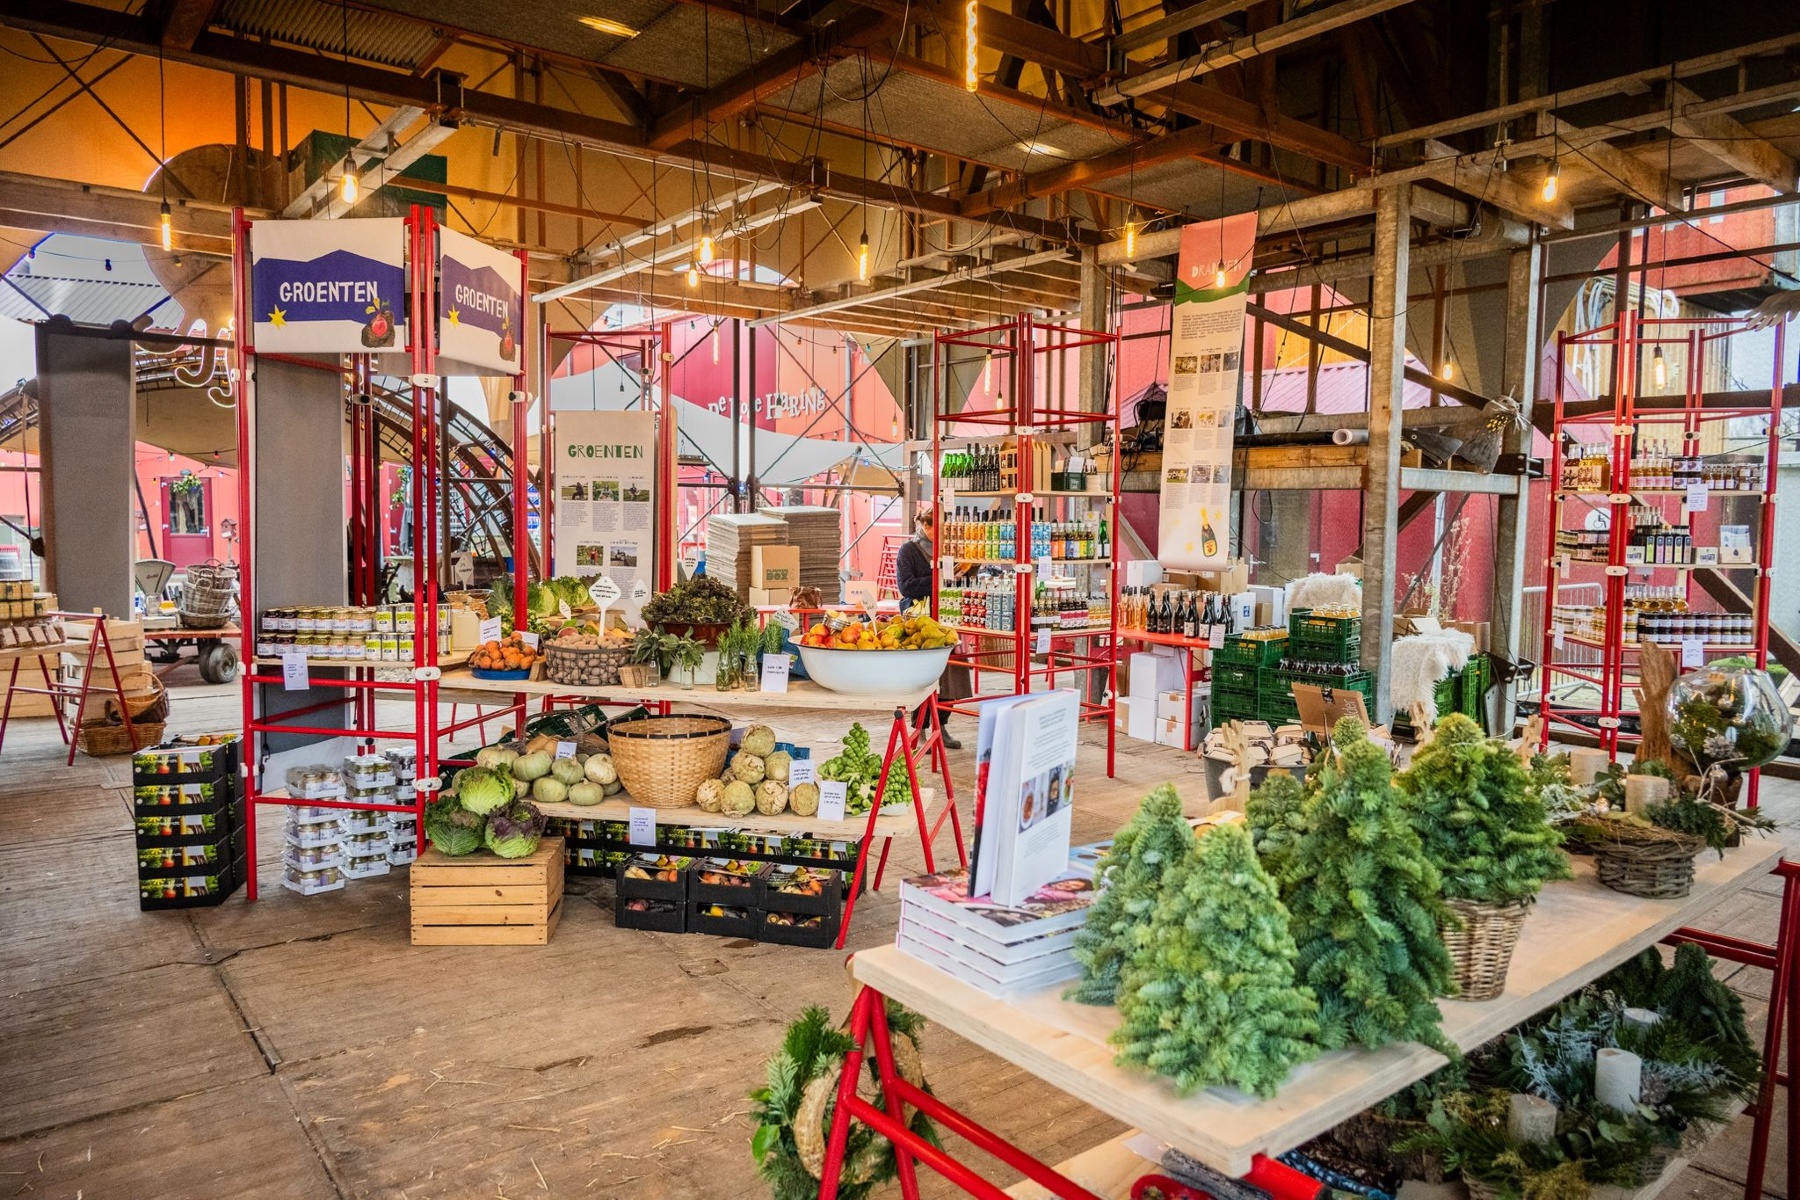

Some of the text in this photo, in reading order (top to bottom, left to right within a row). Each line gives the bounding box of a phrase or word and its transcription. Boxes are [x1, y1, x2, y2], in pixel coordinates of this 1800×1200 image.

[279, 281, 378, 303] GROENTEN
[455, 284, 509, 318] GROENTEN
[568, 444, 643, 458] GROENTEN
[766, 572, 788, 581] BOX
